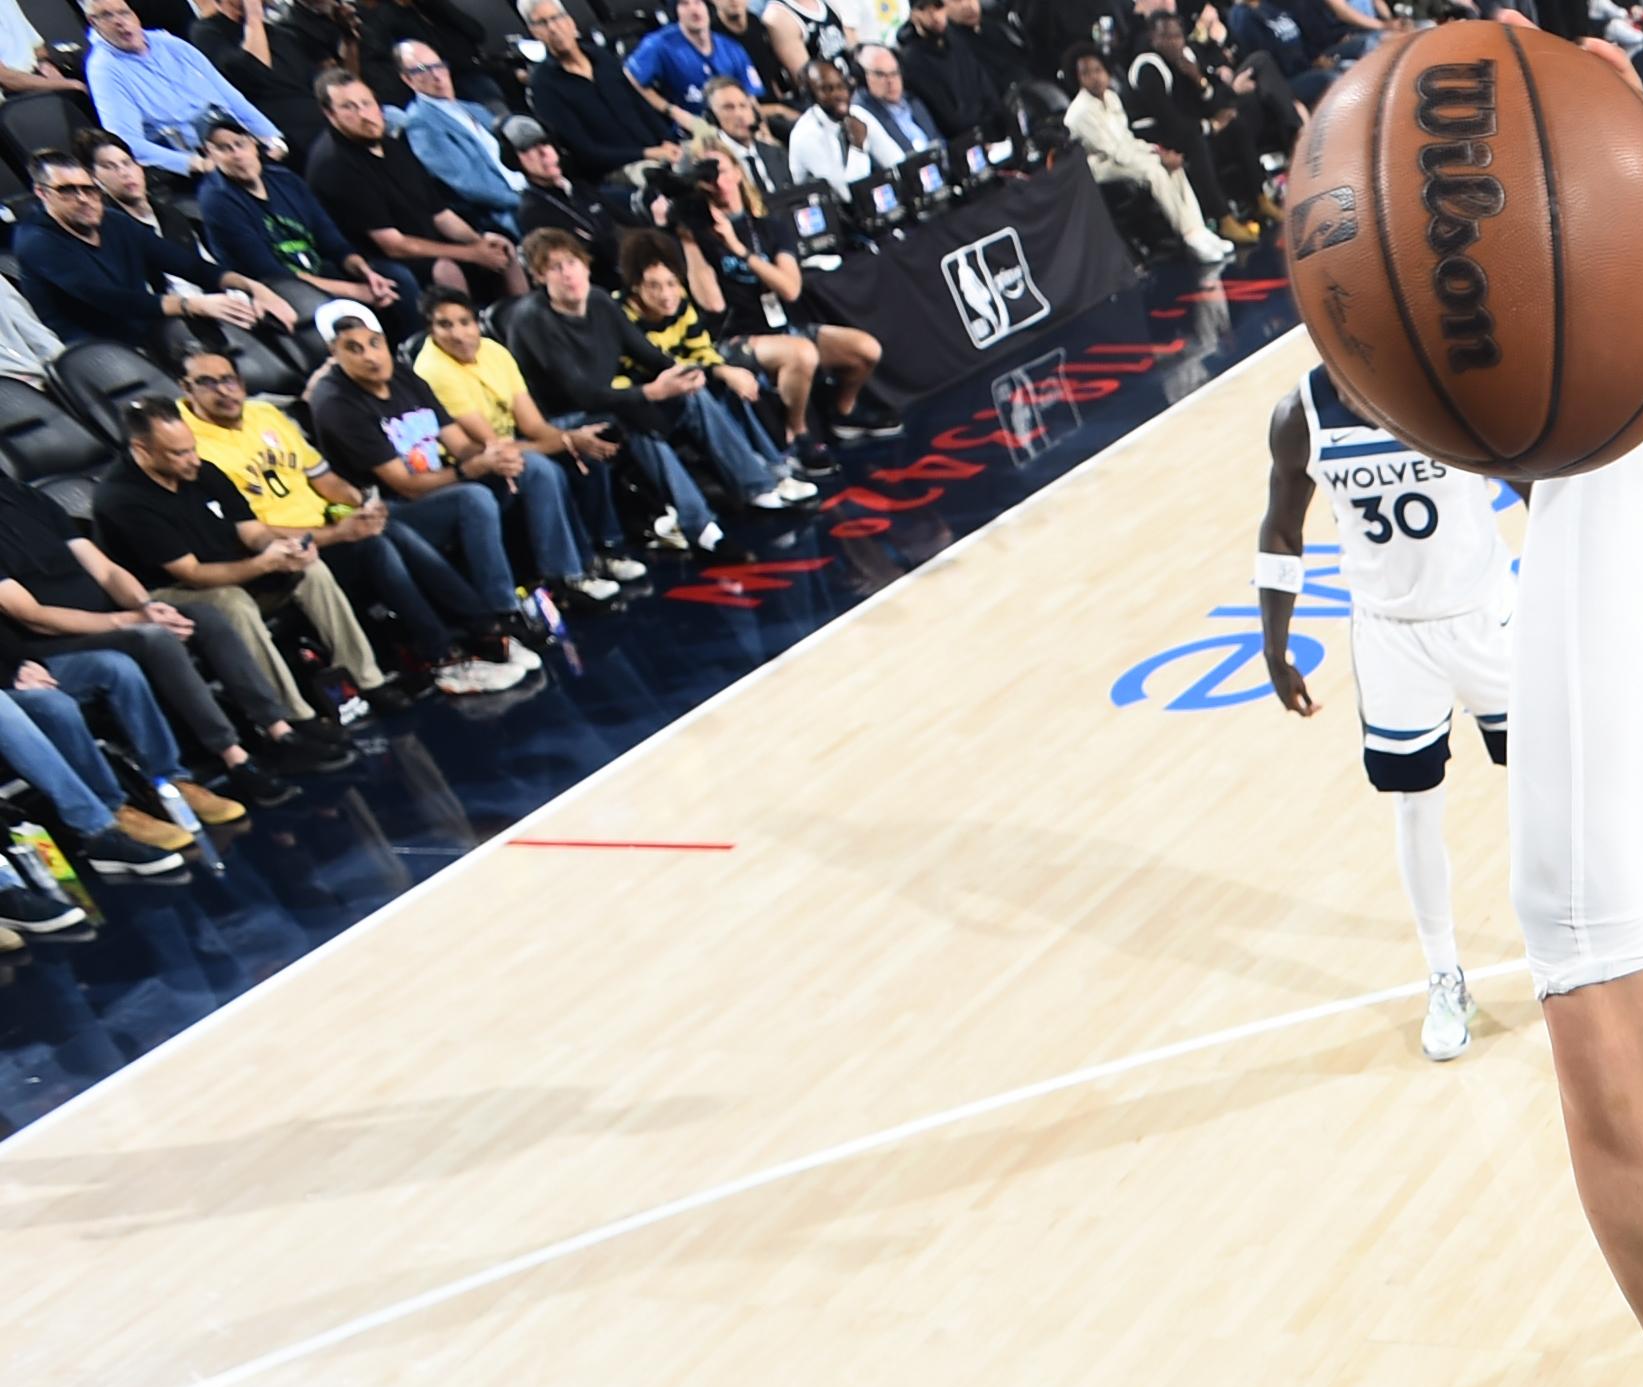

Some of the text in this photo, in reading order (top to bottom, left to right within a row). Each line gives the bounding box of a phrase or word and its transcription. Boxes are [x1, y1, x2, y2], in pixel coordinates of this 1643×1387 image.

[1415, 57, 1505, 377] Wilson
[1323, 458, 1448, 491] WOLVES
[1350, 492, 1439, 544] 30
